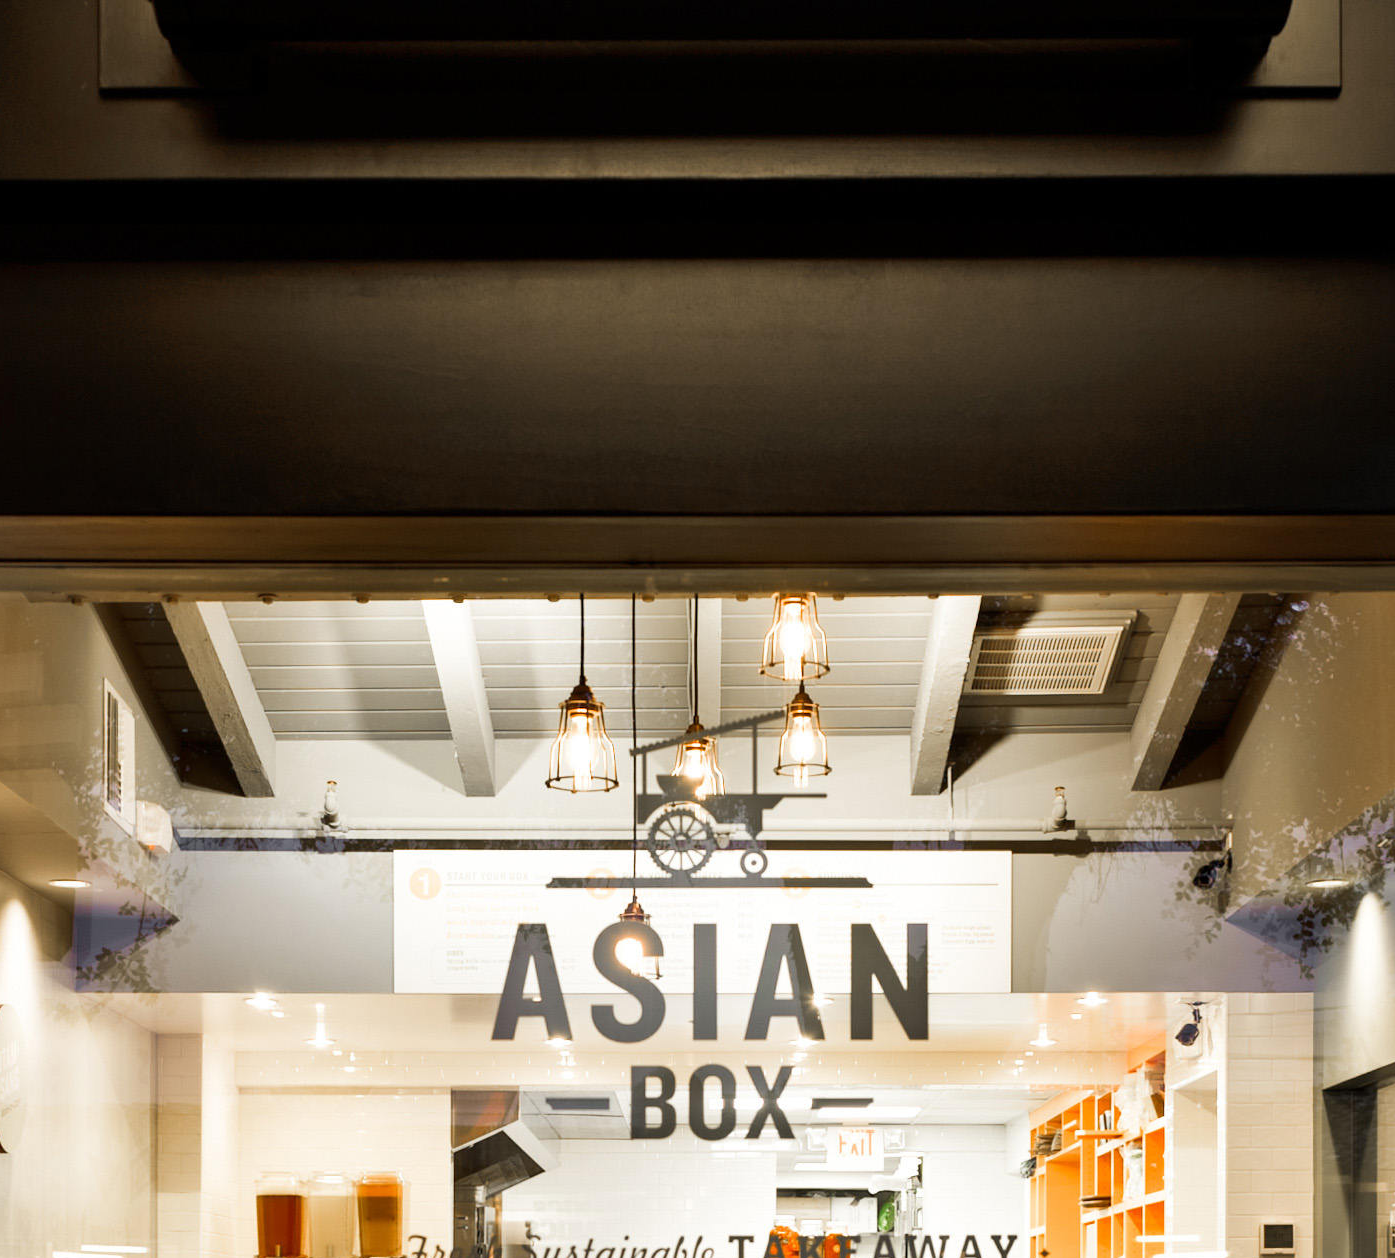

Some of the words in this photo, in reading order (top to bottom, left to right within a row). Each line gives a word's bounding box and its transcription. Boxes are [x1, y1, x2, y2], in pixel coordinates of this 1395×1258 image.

[446, 871, 477, 881] START
[480, 871, 507, 881] YOUR
[509, 871, 529, 881] BOX
[490, 922, 929, 1042] ASIAN
[630, 1063, 796, 1142] BOX
